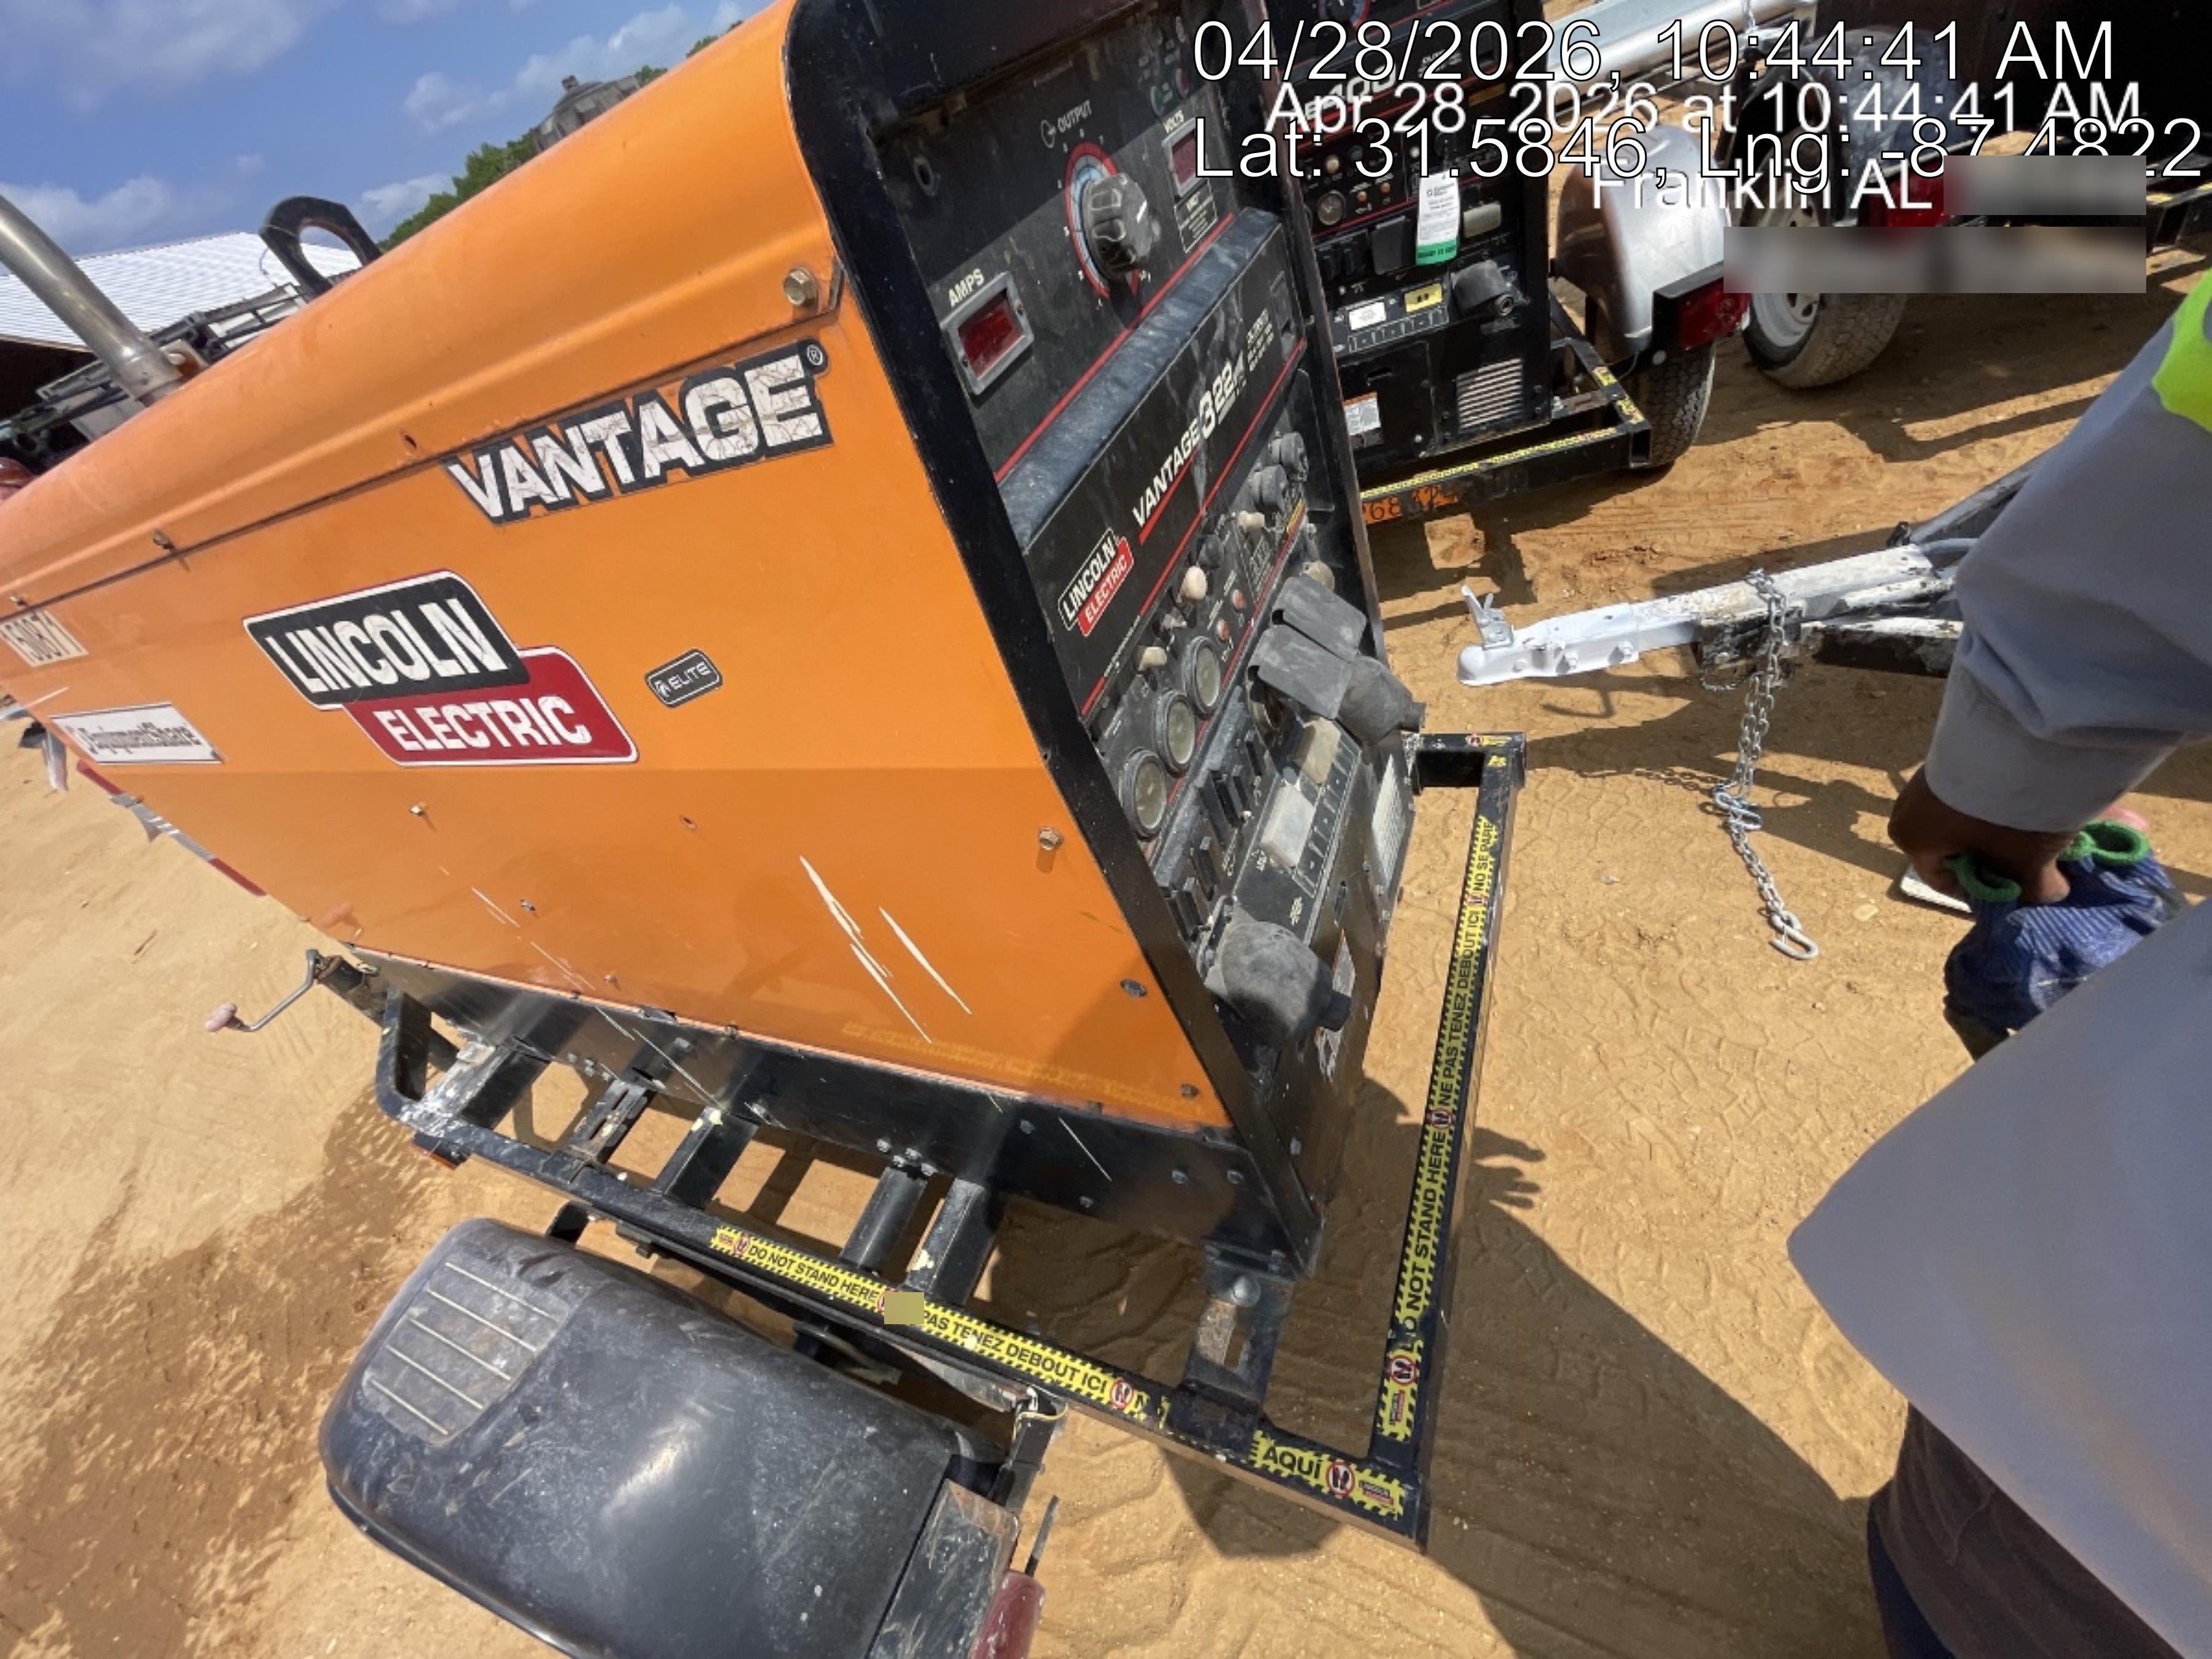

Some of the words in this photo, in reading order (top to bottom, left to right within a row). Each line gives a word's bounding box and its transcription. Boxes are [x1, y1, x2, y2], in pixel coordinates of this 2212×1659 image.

[1057, 99, 1092, 133] OUTPUT
[948, 268, 985, 307] AMPS
[447, 354, 823, 517] VANTAGE
[1131, 418, 1199, 527] VANTAGE
[1062, 536, 1116, 622] LINCOLN
[1084, 554, 1127, 624] ELECTRIC
[264, 597, 509, 694] LINCOLN
[668, 661, 712, 689] ELITE
[372, 695, 593, 751] ELECTRIC
[1472, 873, 1486, 891] NO
[1476, 855, 1489, 871] SE
[1467, 910, 1480, 928] ICI
[1457, 930, 1476, 989] DEBOUT
[1448, 992, 1467, 1042] TENEZ
[1443, 1046, 1459, 1079] PAS
[1437, 1082, 1454, 1107] NE
[1427, 1131, 1446, 1183] HERE
[1415, 1188, 1437, 1259] STAND
[1406, 1261, 1426, 1311] NOT
[748, 1245, 767, 1261] DO
[767, 1253, 795, 1271] NOT
[796, 1263, 840, 1287] STAND
[840, 1279, 880, 1301] HERE
[952, 1319, 1005, 1352] TENEZ
[1006, 1342, 1081, 1381] DEBOUT
[1081, 1373, 1108, 1394] ICI
